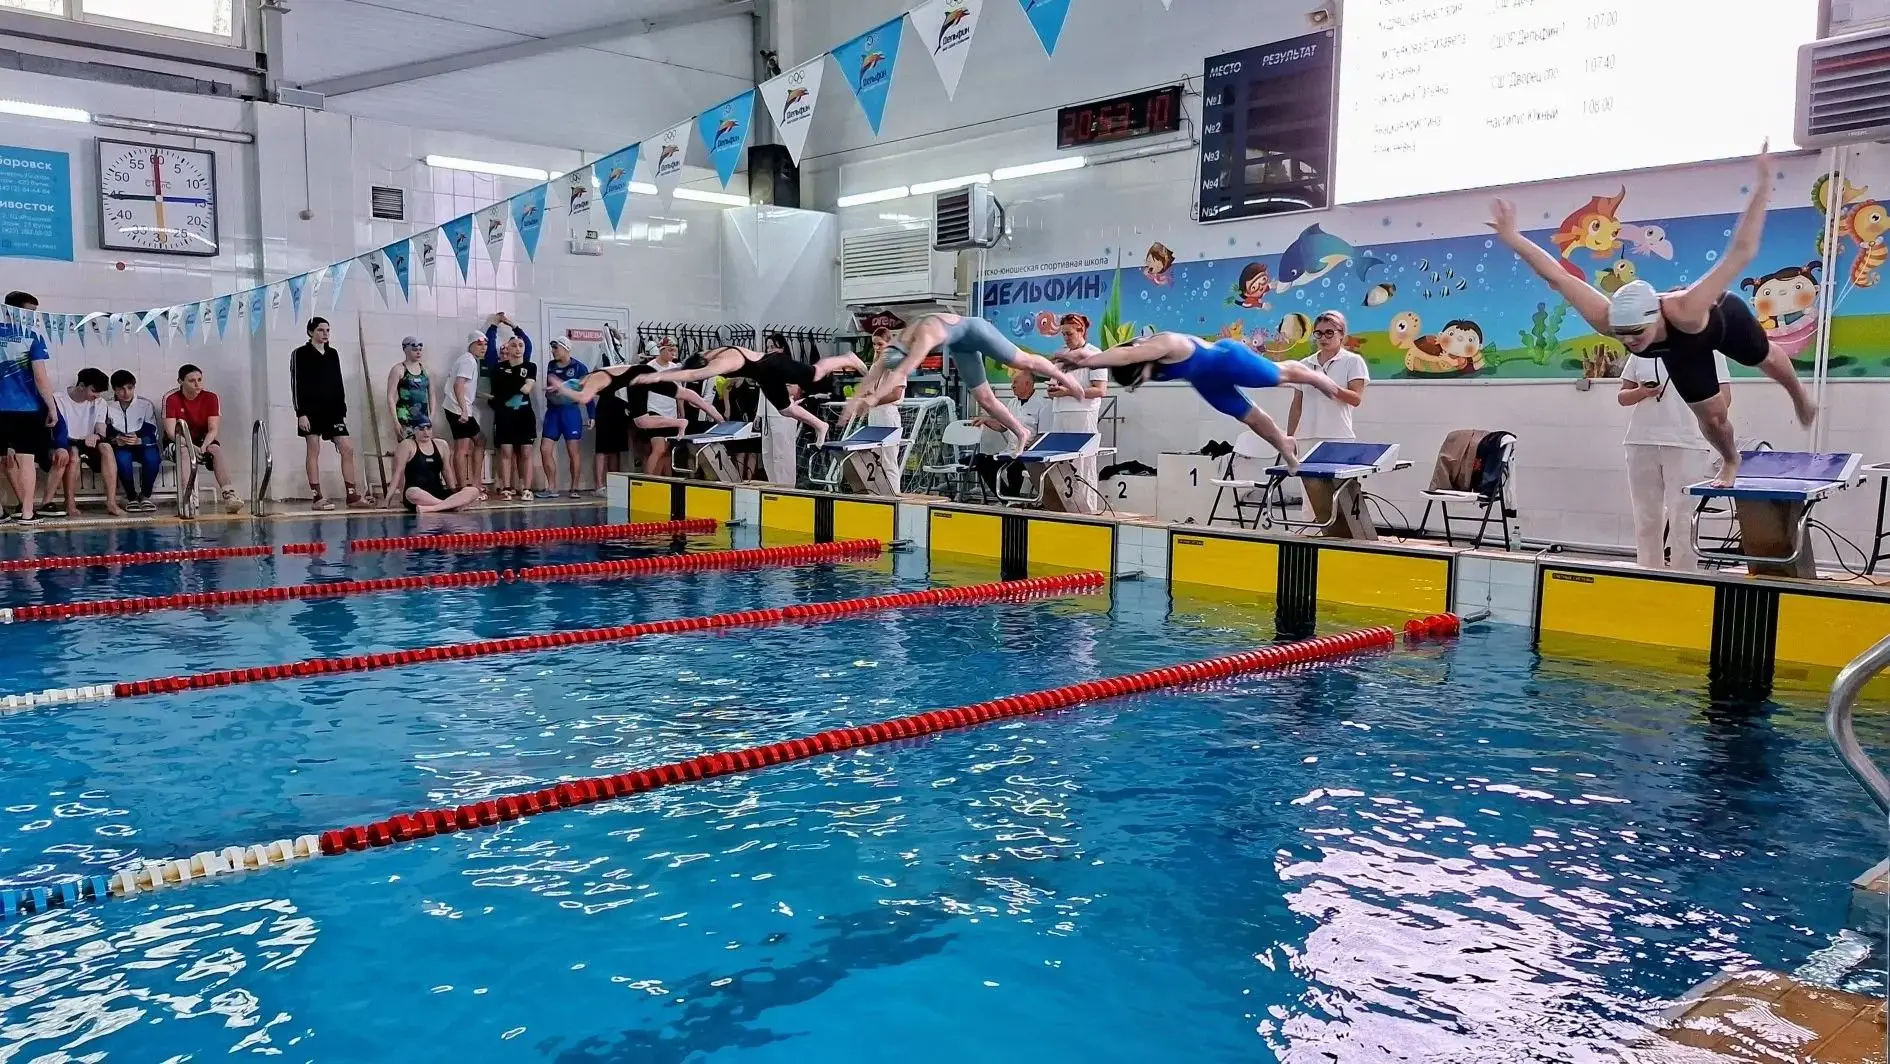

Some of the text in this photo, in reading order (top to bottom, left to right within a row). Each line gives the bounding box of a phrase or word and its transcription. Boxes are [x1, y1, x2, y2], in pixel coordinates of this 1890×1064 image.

[1209, 44, 1317, 78] МЕСТО РЕЗУЛЬТАТ
[1206, 93, 1222, 107] №1
[1204, 122, 1221, 135] №2
[0, 155, 52, 171] аровск
[1203, 150, 1220, 163] №3
[129, 159, 144, 170] 55
[174, 164, 181, 174] 5
[114, 171, 130, 182] 50
[186, 179, 200, 190] 10
[1202, 178, 1219, 191] №4
[117, 209, 132, 220] 40
[1201, 207, 1219, 218] №5
[186, 215, 202, 226] 20
[173, 228, 188, 238] 25
[1040, 260, 1082, 274] спортивная
[1084, 257, 1109, 266] школа
[714, 450, 723, 471] 1
[866, 462, 876, 482] 2
[1189, 468, 1198, 487] 1
[1064, 475, 1073, 499] 3
[1117, 481, 1128, 499] 2
[1351, 493, 1360, 520] 4
